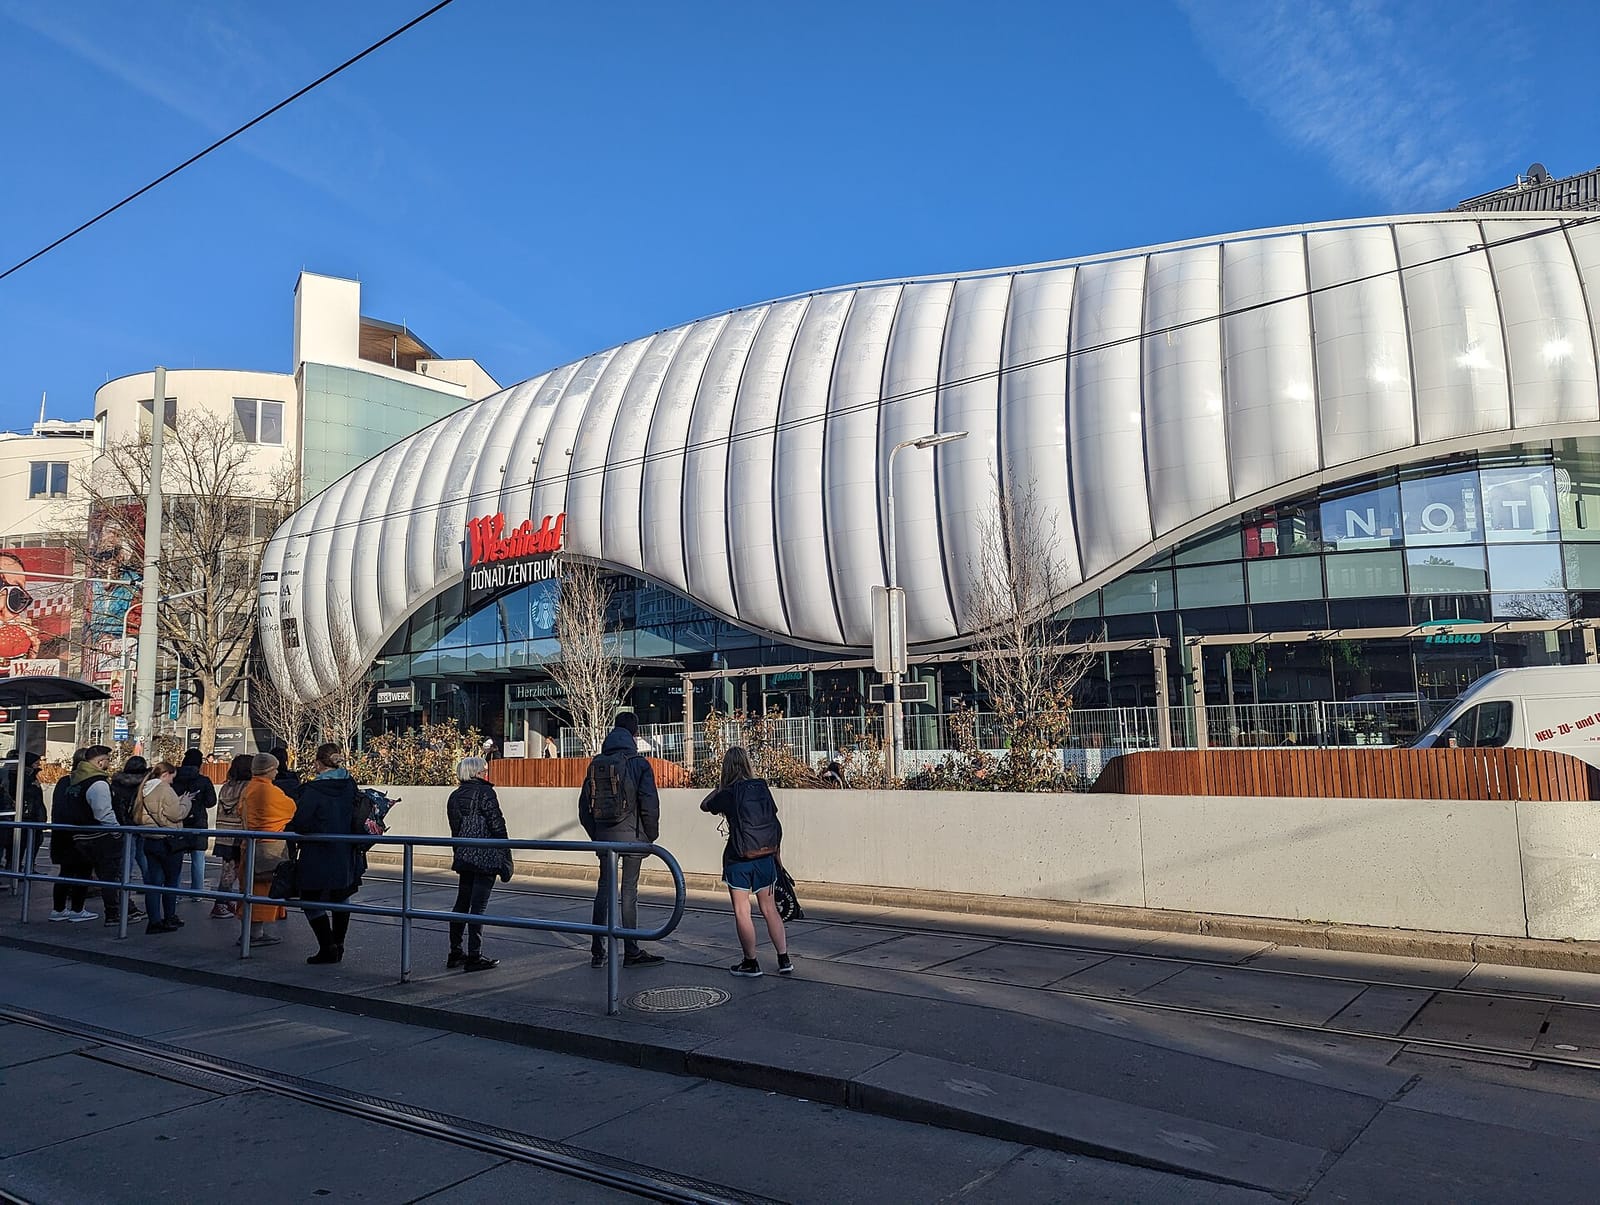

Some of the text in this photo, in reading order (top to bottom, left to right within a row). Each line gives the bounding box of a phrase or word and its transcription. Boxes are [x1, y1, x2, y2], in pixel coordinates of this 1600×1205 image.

[467, 511, 566, 566] Westfield
[471, 558, 558, 591] DONAU ZENTRUM
[13, 662, 56, 676] Westfield
[516, 685, 553, 699] Herzlich
[1535, 729, 1557, 742] NEU-
[1557, 724, 1574, 735] ZU-
[1575, 716, 1595, 729] und
